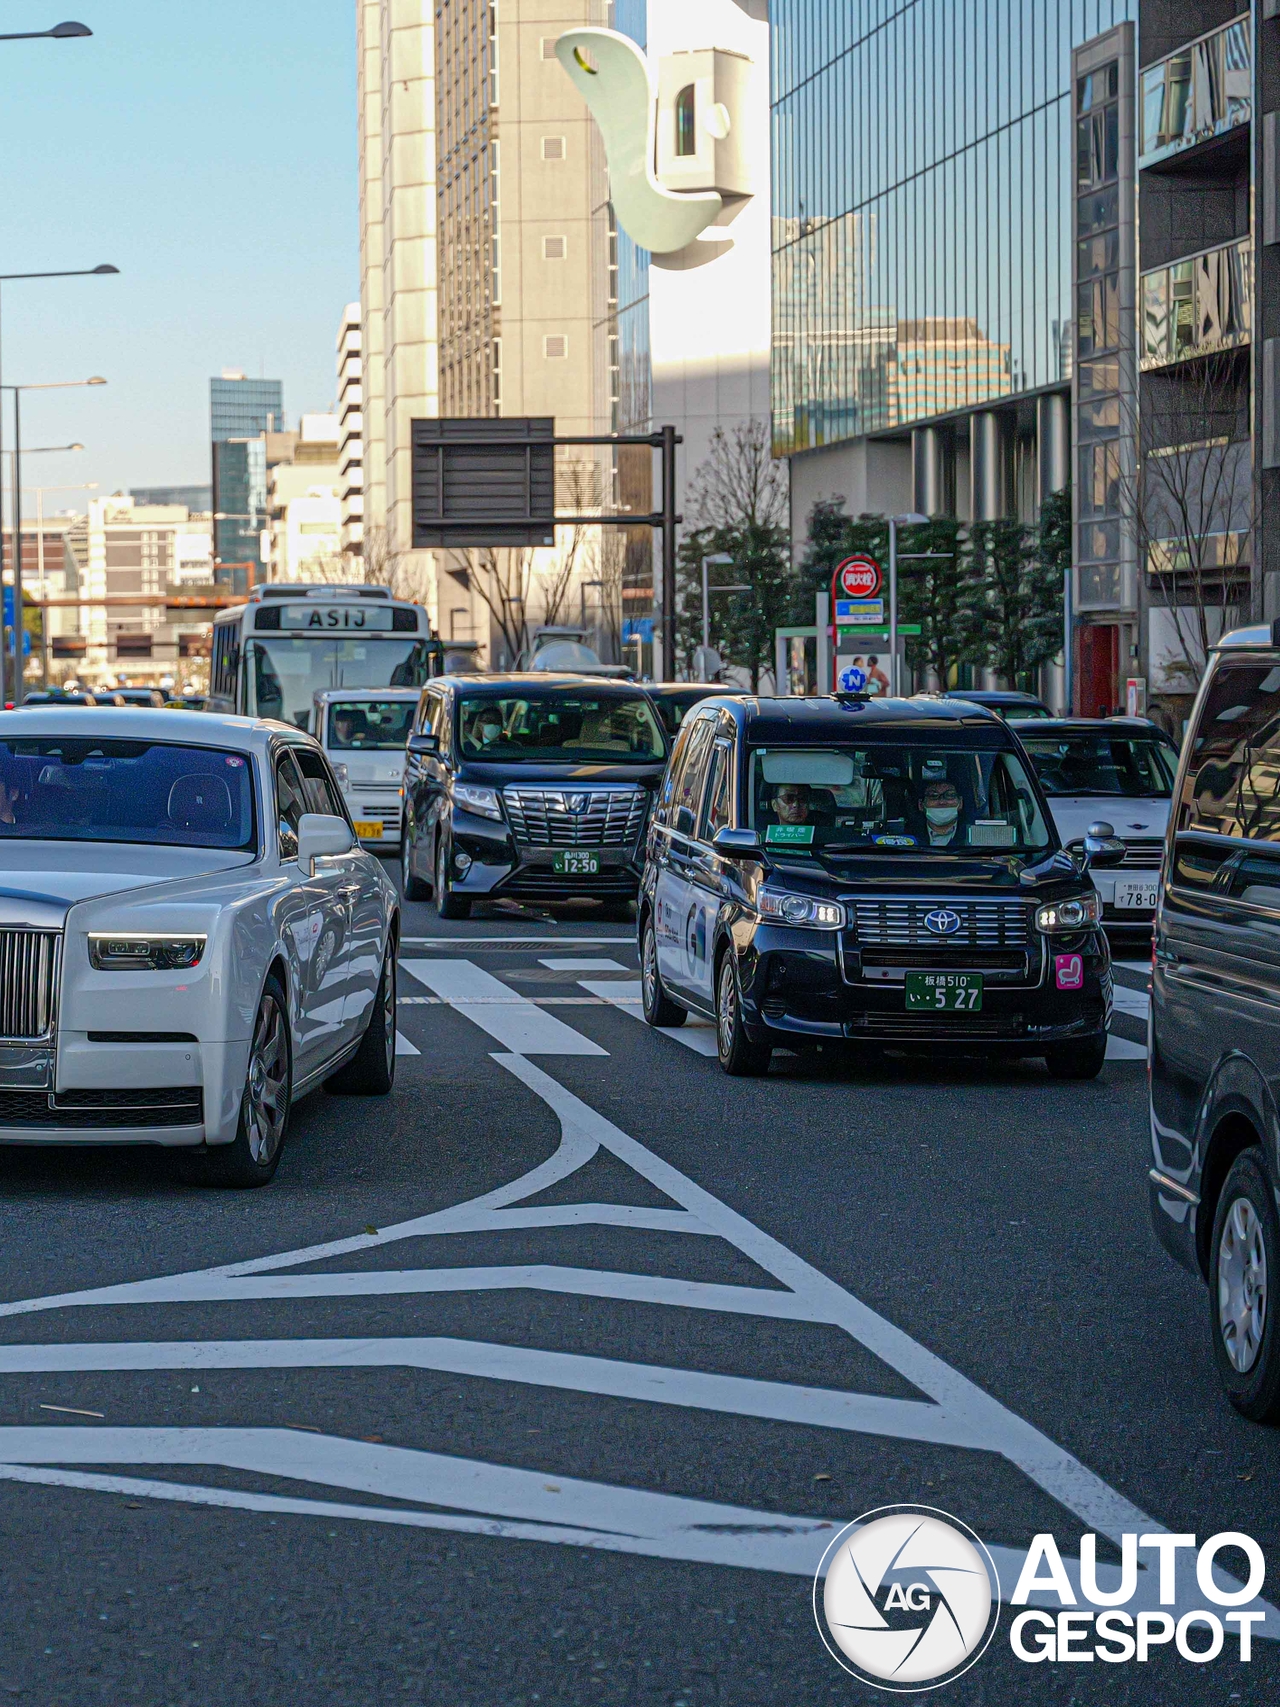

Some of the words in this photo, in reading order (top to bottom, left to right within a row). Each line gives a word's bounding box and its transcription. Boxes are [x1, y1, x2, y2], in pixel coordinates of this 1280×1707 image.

[845, 572, 872, 586] 消火栓
[308, 609, 366, 627] ASIJ
[848, 675, 860, 687] N
[565, 859, 597, 872] 12-50
[1127, 893, 1157, 906] 78-0
[925, 975, 967, 987] 板橋510
